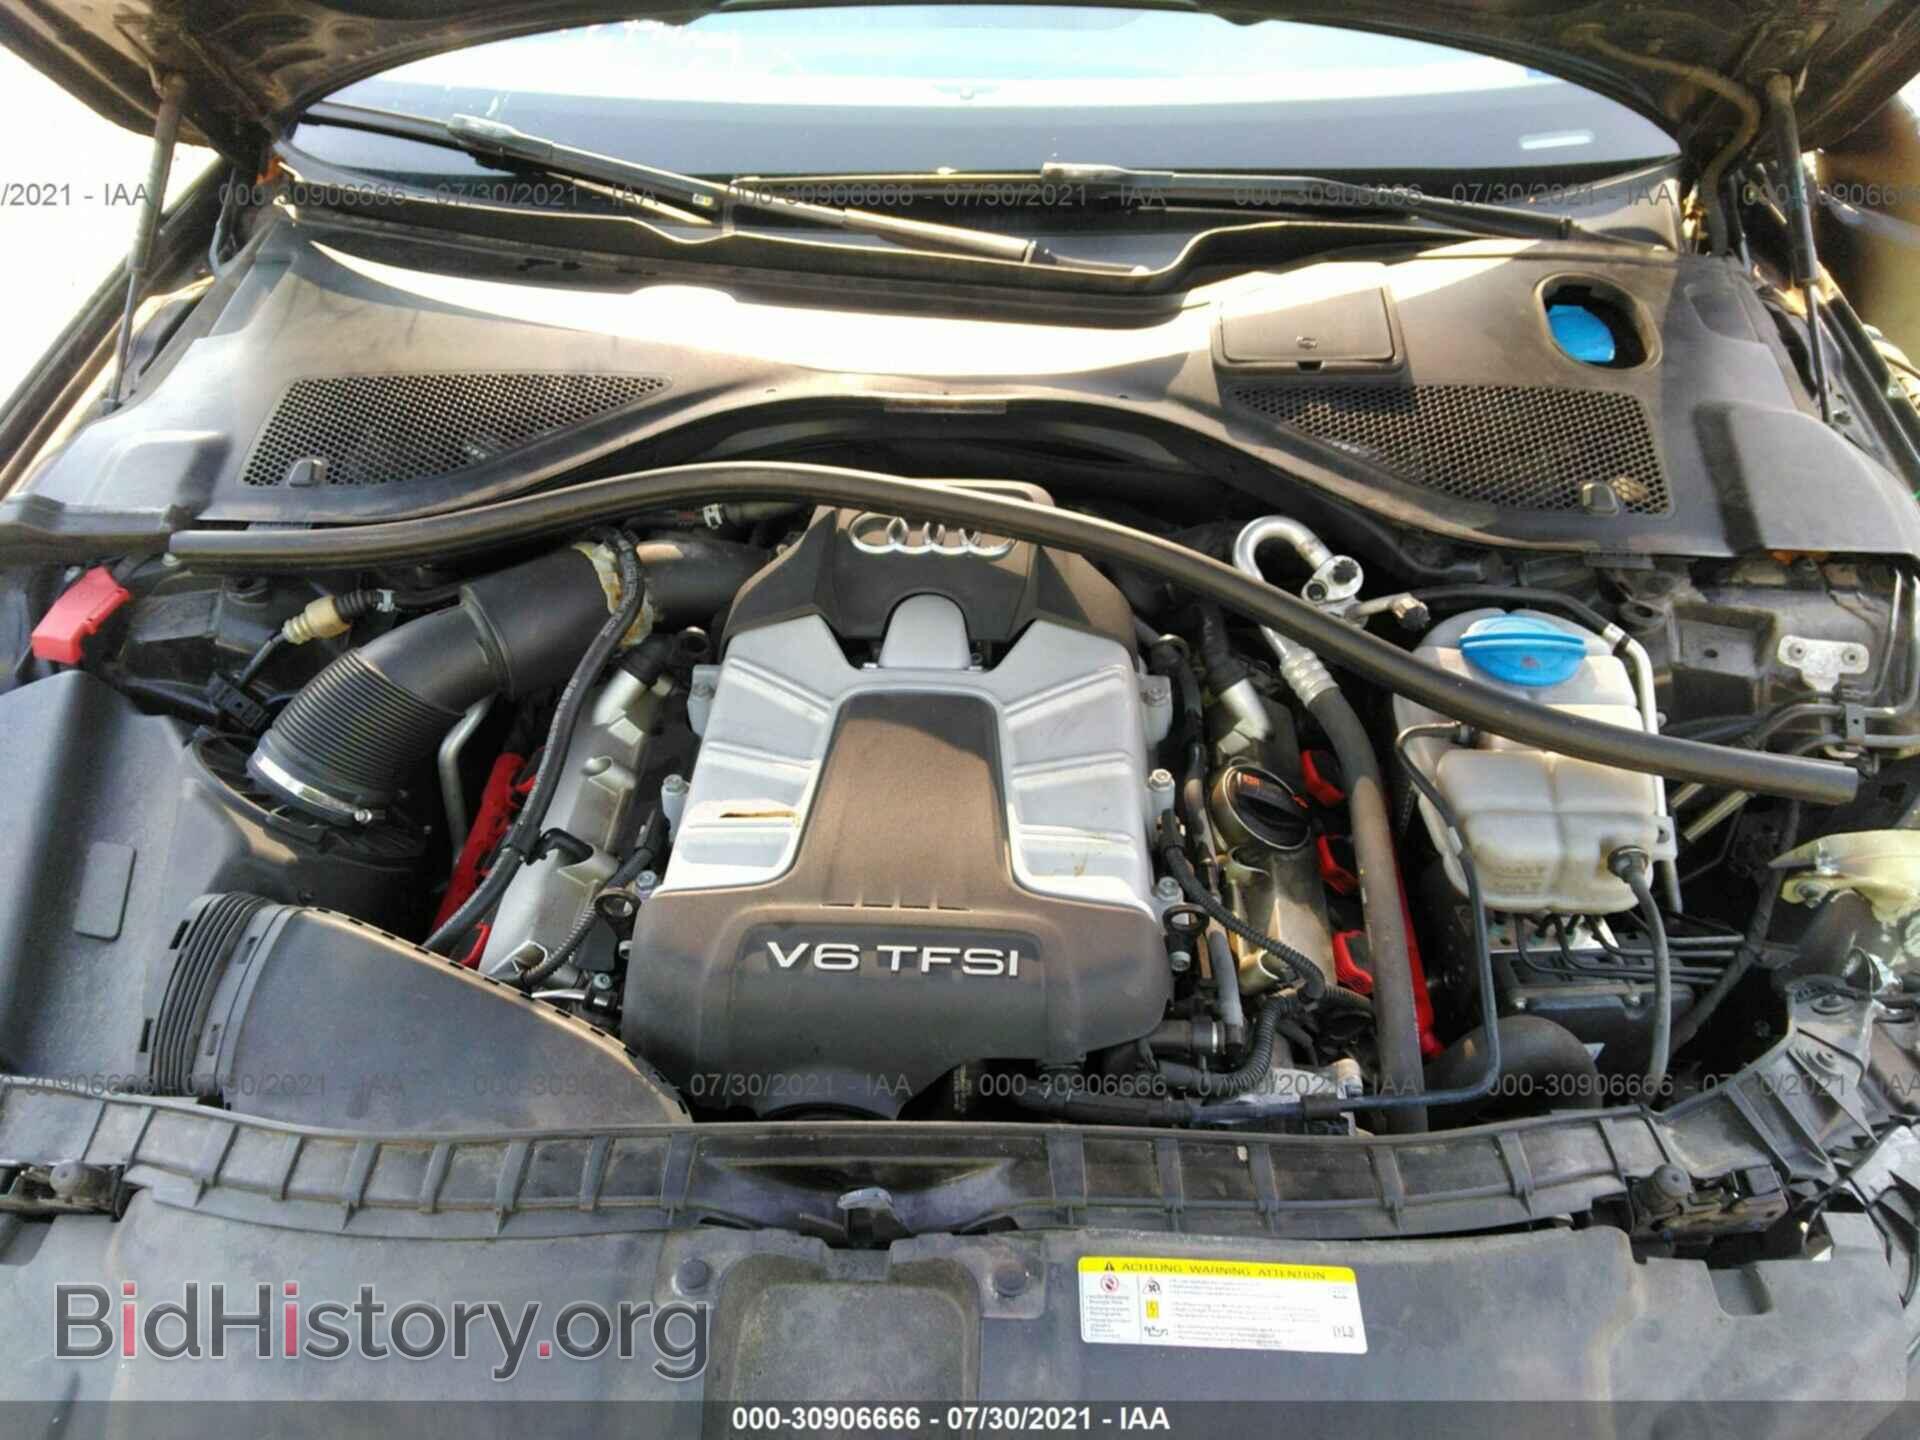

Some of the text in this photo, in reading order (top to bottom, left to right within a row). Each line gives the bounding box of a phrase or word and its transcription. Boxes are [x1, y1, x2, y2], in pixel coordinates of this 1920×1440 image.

[767, 942, 1020, 977] V6 TFSI
[1121, 1262, 1327, 1281] ACHTUNG WARNING ATTENTION
